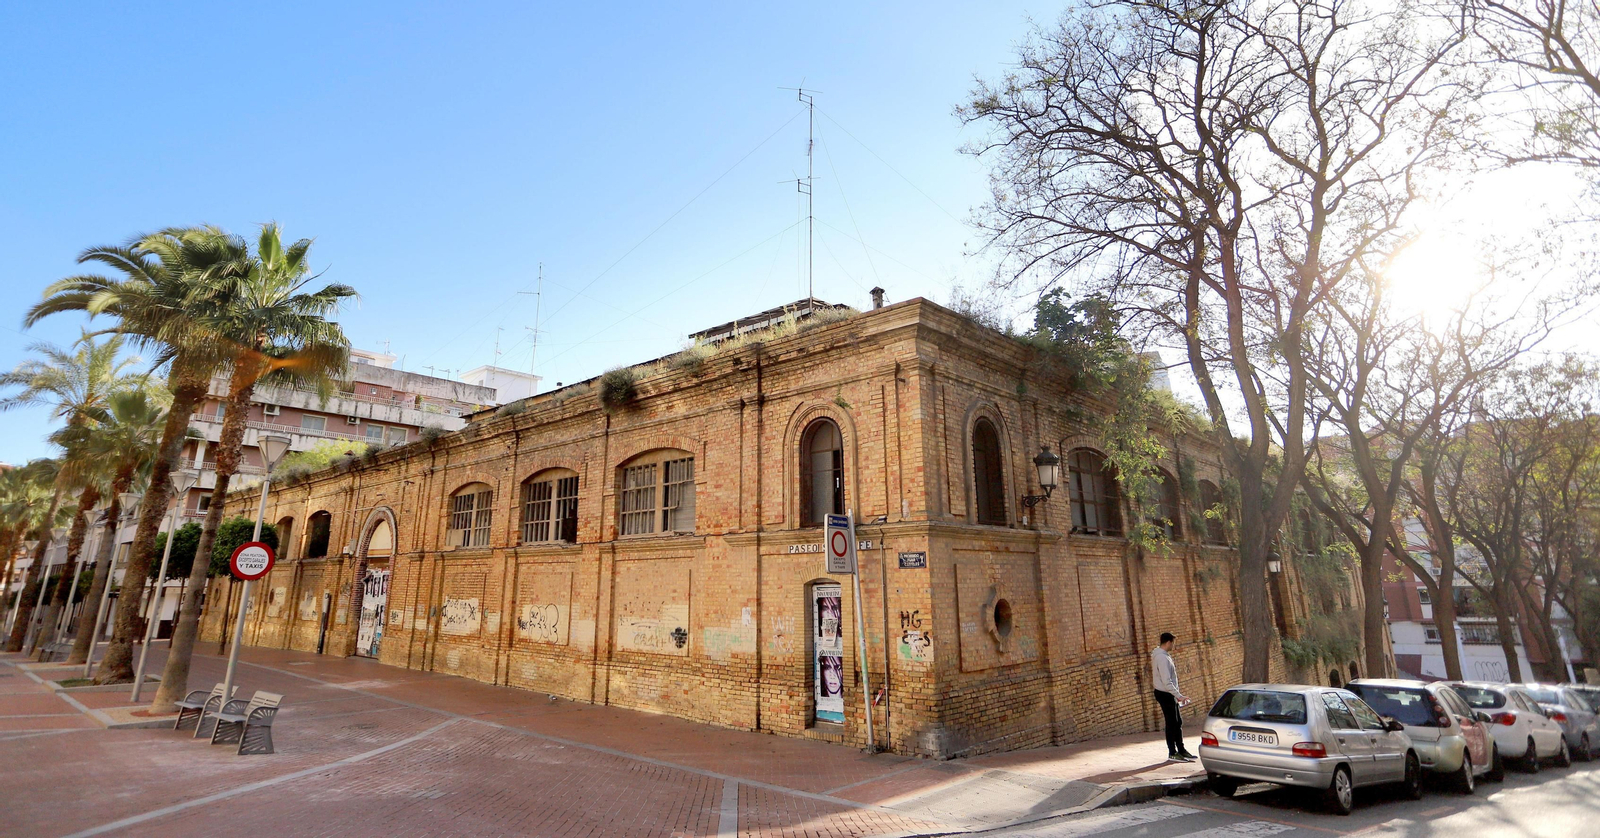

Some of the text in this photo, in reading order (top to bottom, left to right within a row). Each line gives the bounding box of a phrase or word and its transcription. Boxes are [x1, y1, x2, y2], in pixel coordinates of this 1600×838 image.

[789, 544, 818, 553] PASEO
[901, 610, 922, 629] HG
[1237, 732, 1274, 744] 9558 BKD
